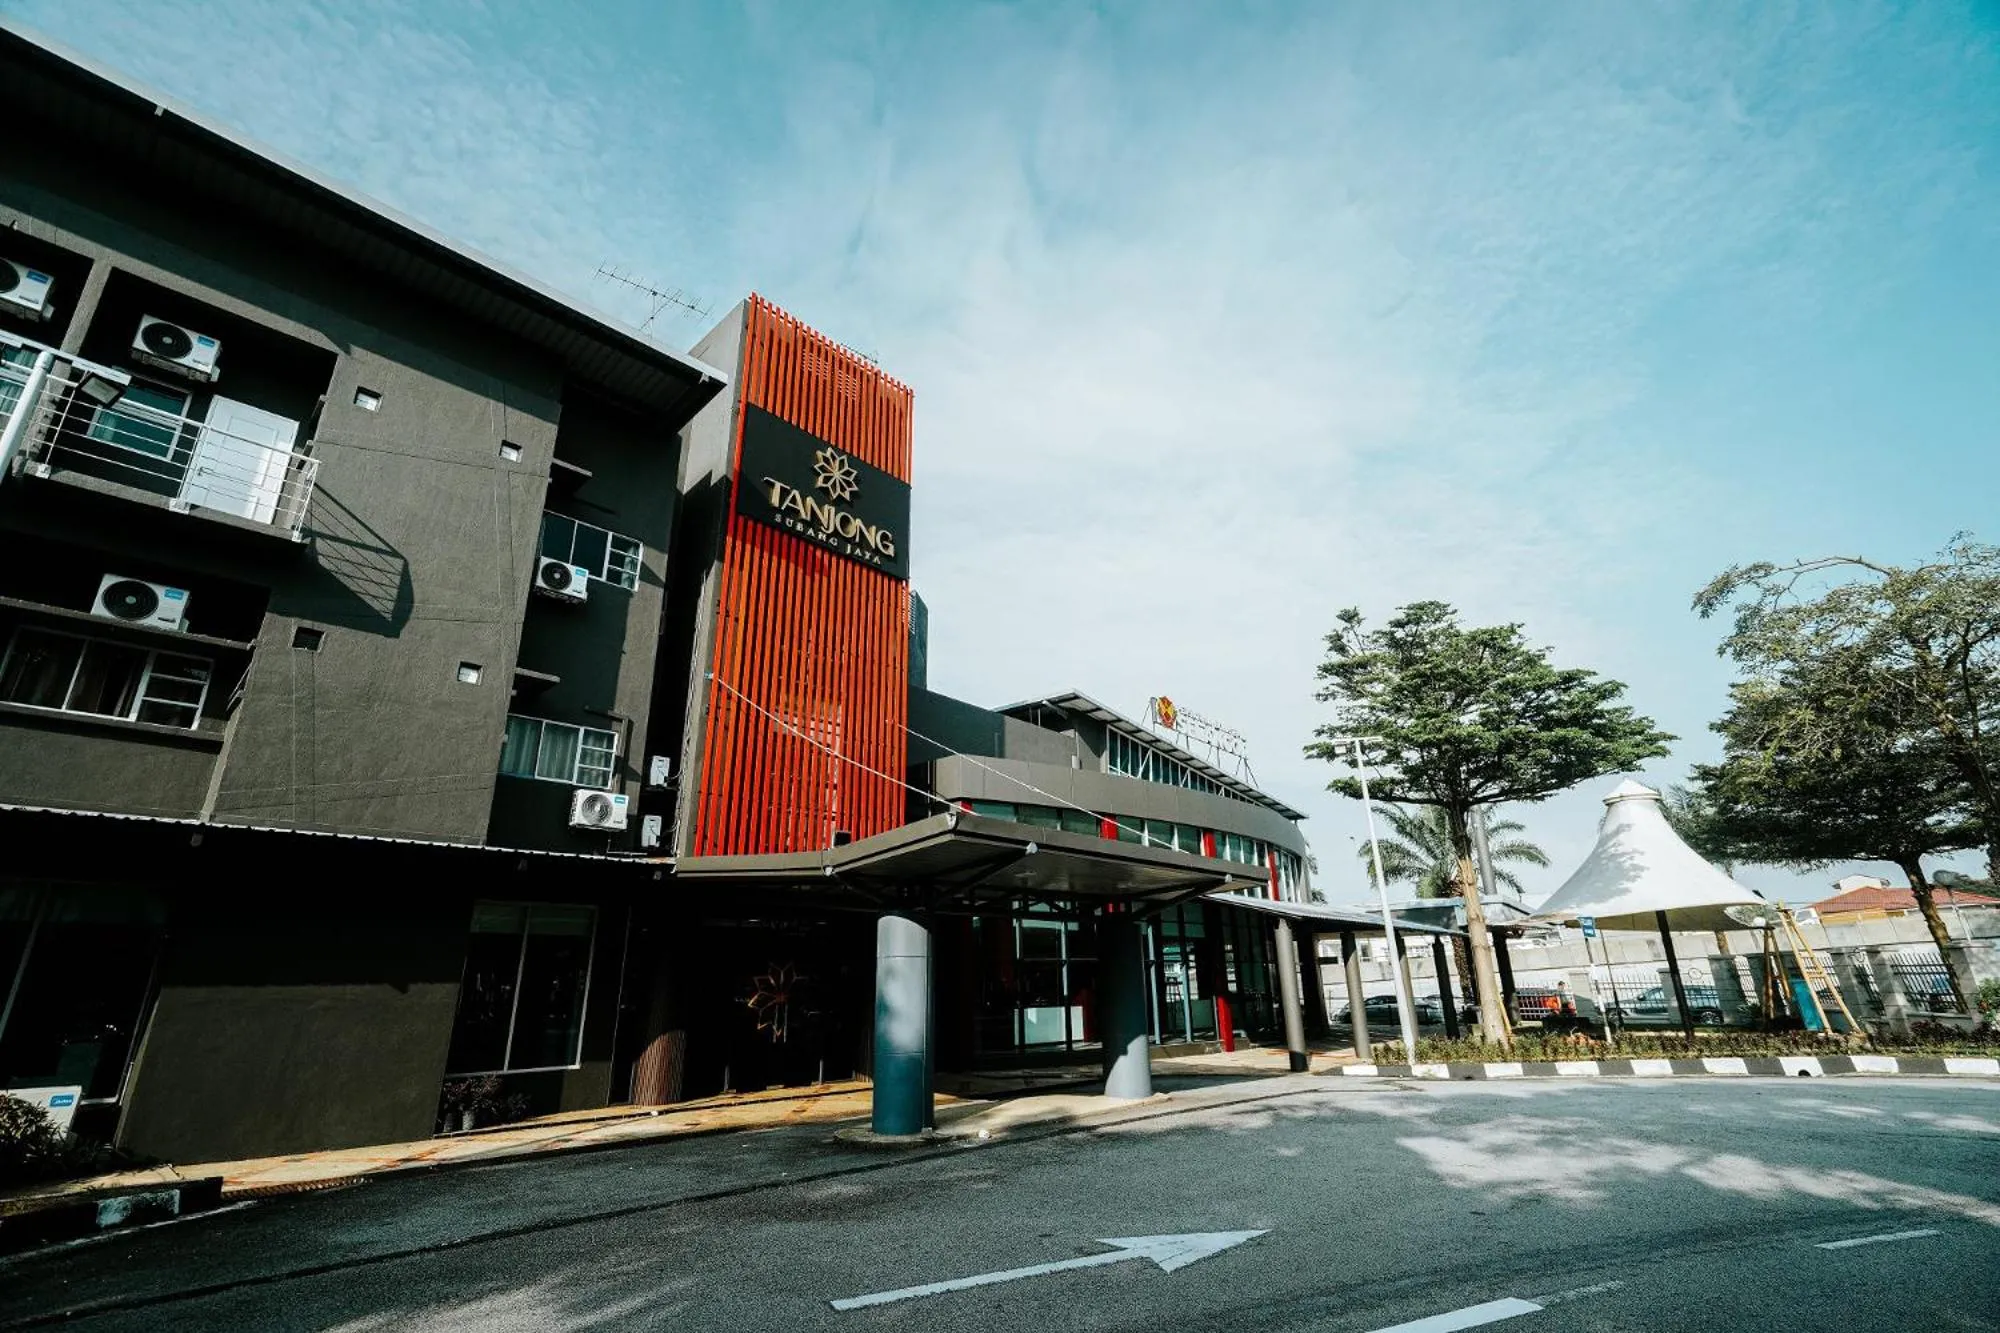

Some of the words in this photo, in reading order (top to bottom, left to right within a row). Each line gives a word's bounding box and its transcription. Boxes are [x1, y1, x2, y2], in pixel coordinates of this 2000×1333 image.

[763, 476, 895, 557] TANJONG
[774, 513, 838, 546] SUBANG
[846, 543, 881, 565] JAYA
